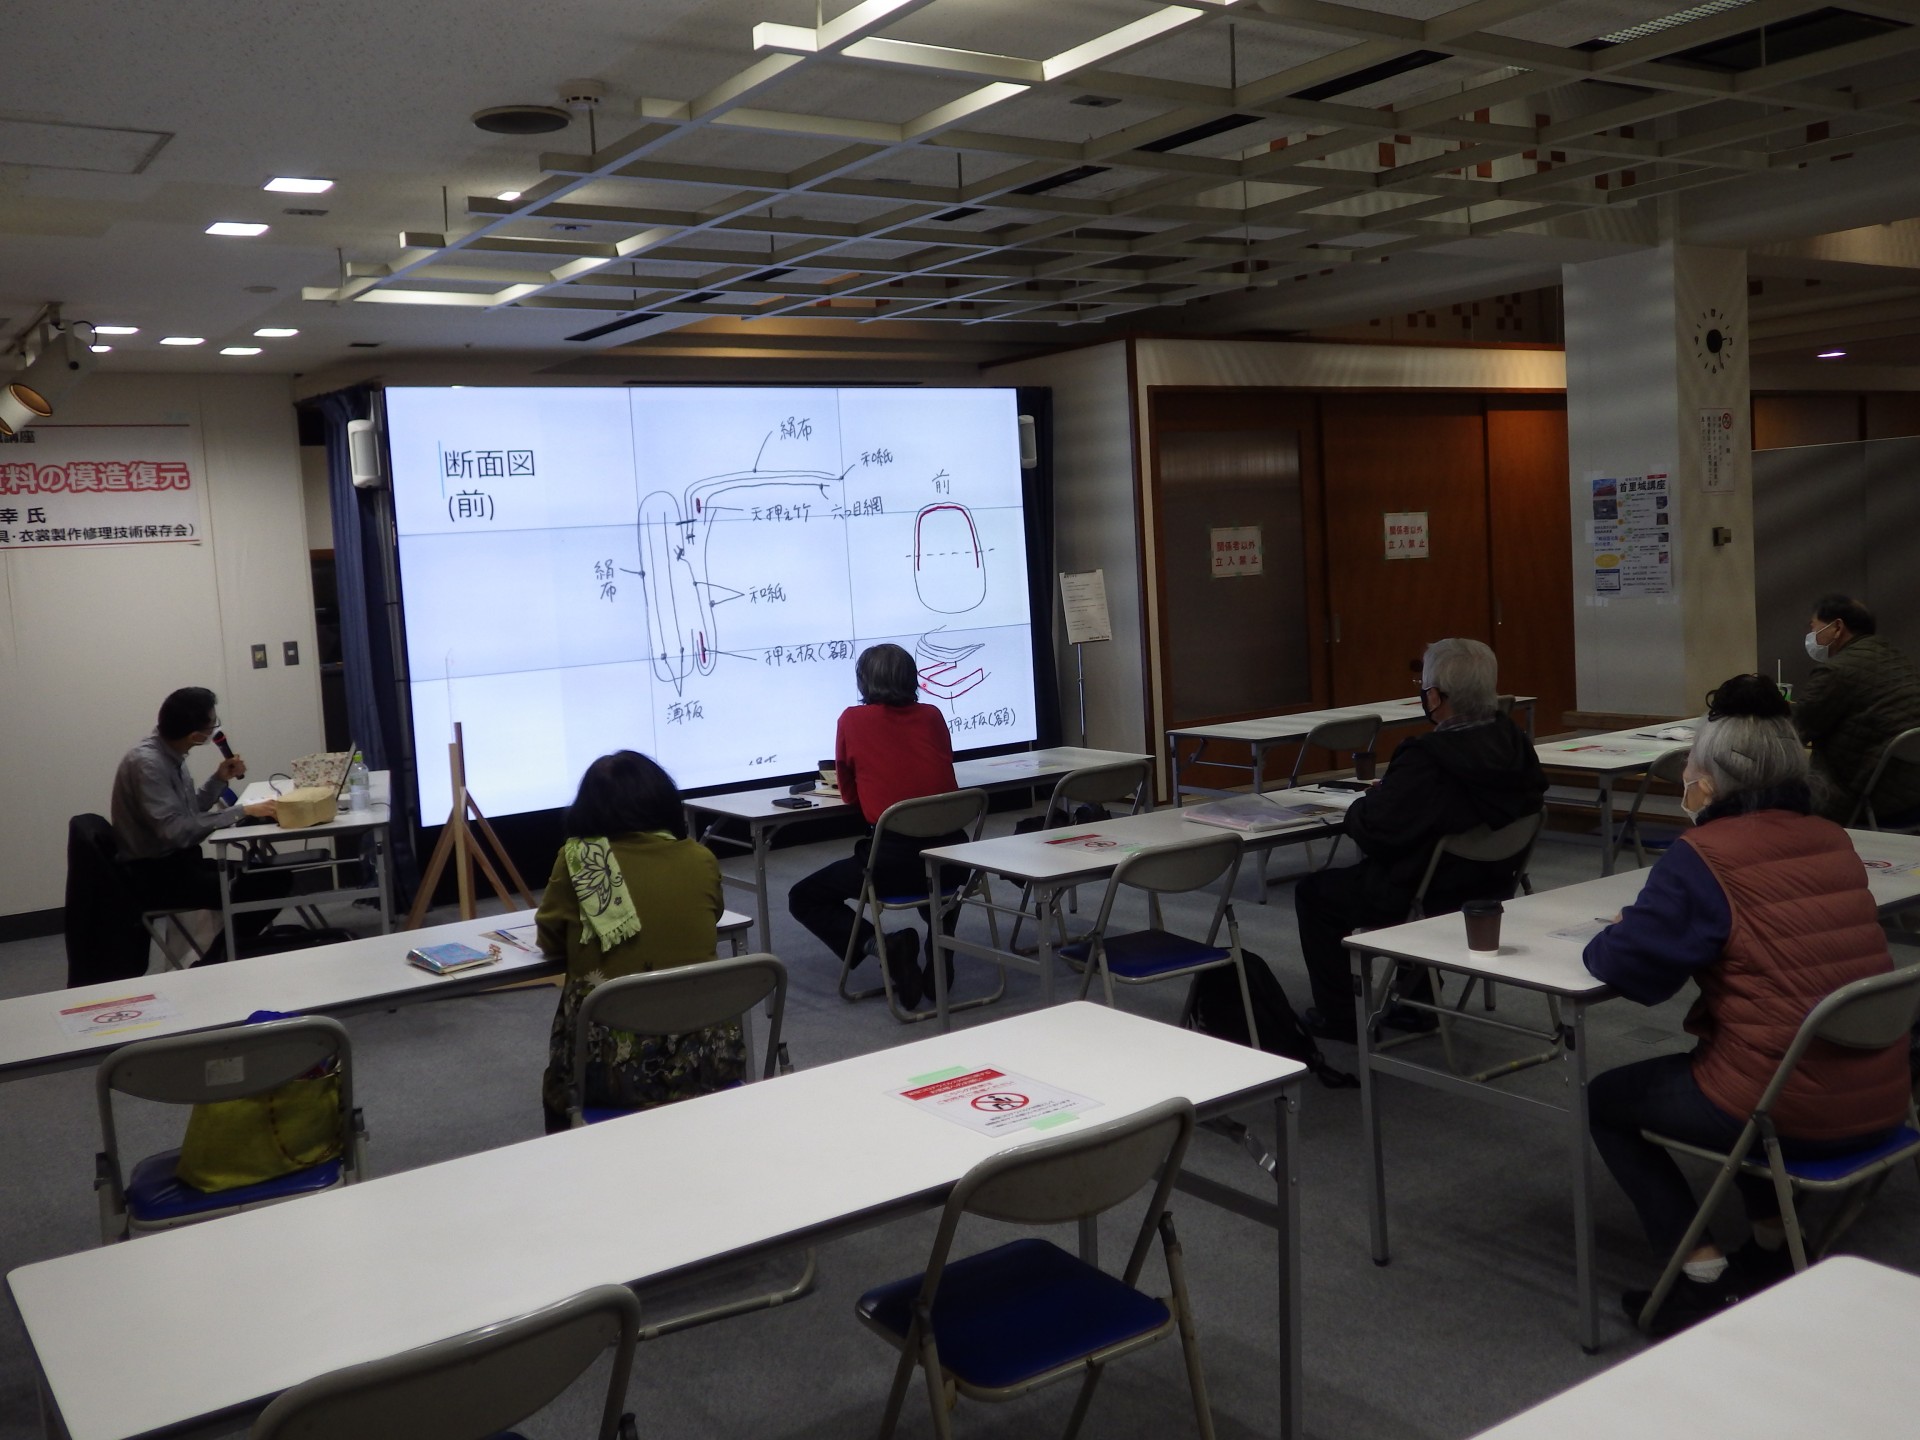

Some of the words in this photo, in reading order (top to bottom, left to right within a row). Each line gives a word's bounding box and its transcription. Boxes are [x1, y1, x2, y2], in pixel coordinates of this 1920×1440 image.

[0, 461, 190, 495] 料の模造復元
[444, 450, 536, 478] 断面図
[931, 468, 950, 495] 前
[27, 507, 47, 524] 氏
[447, 489, 495, 522] (前)
